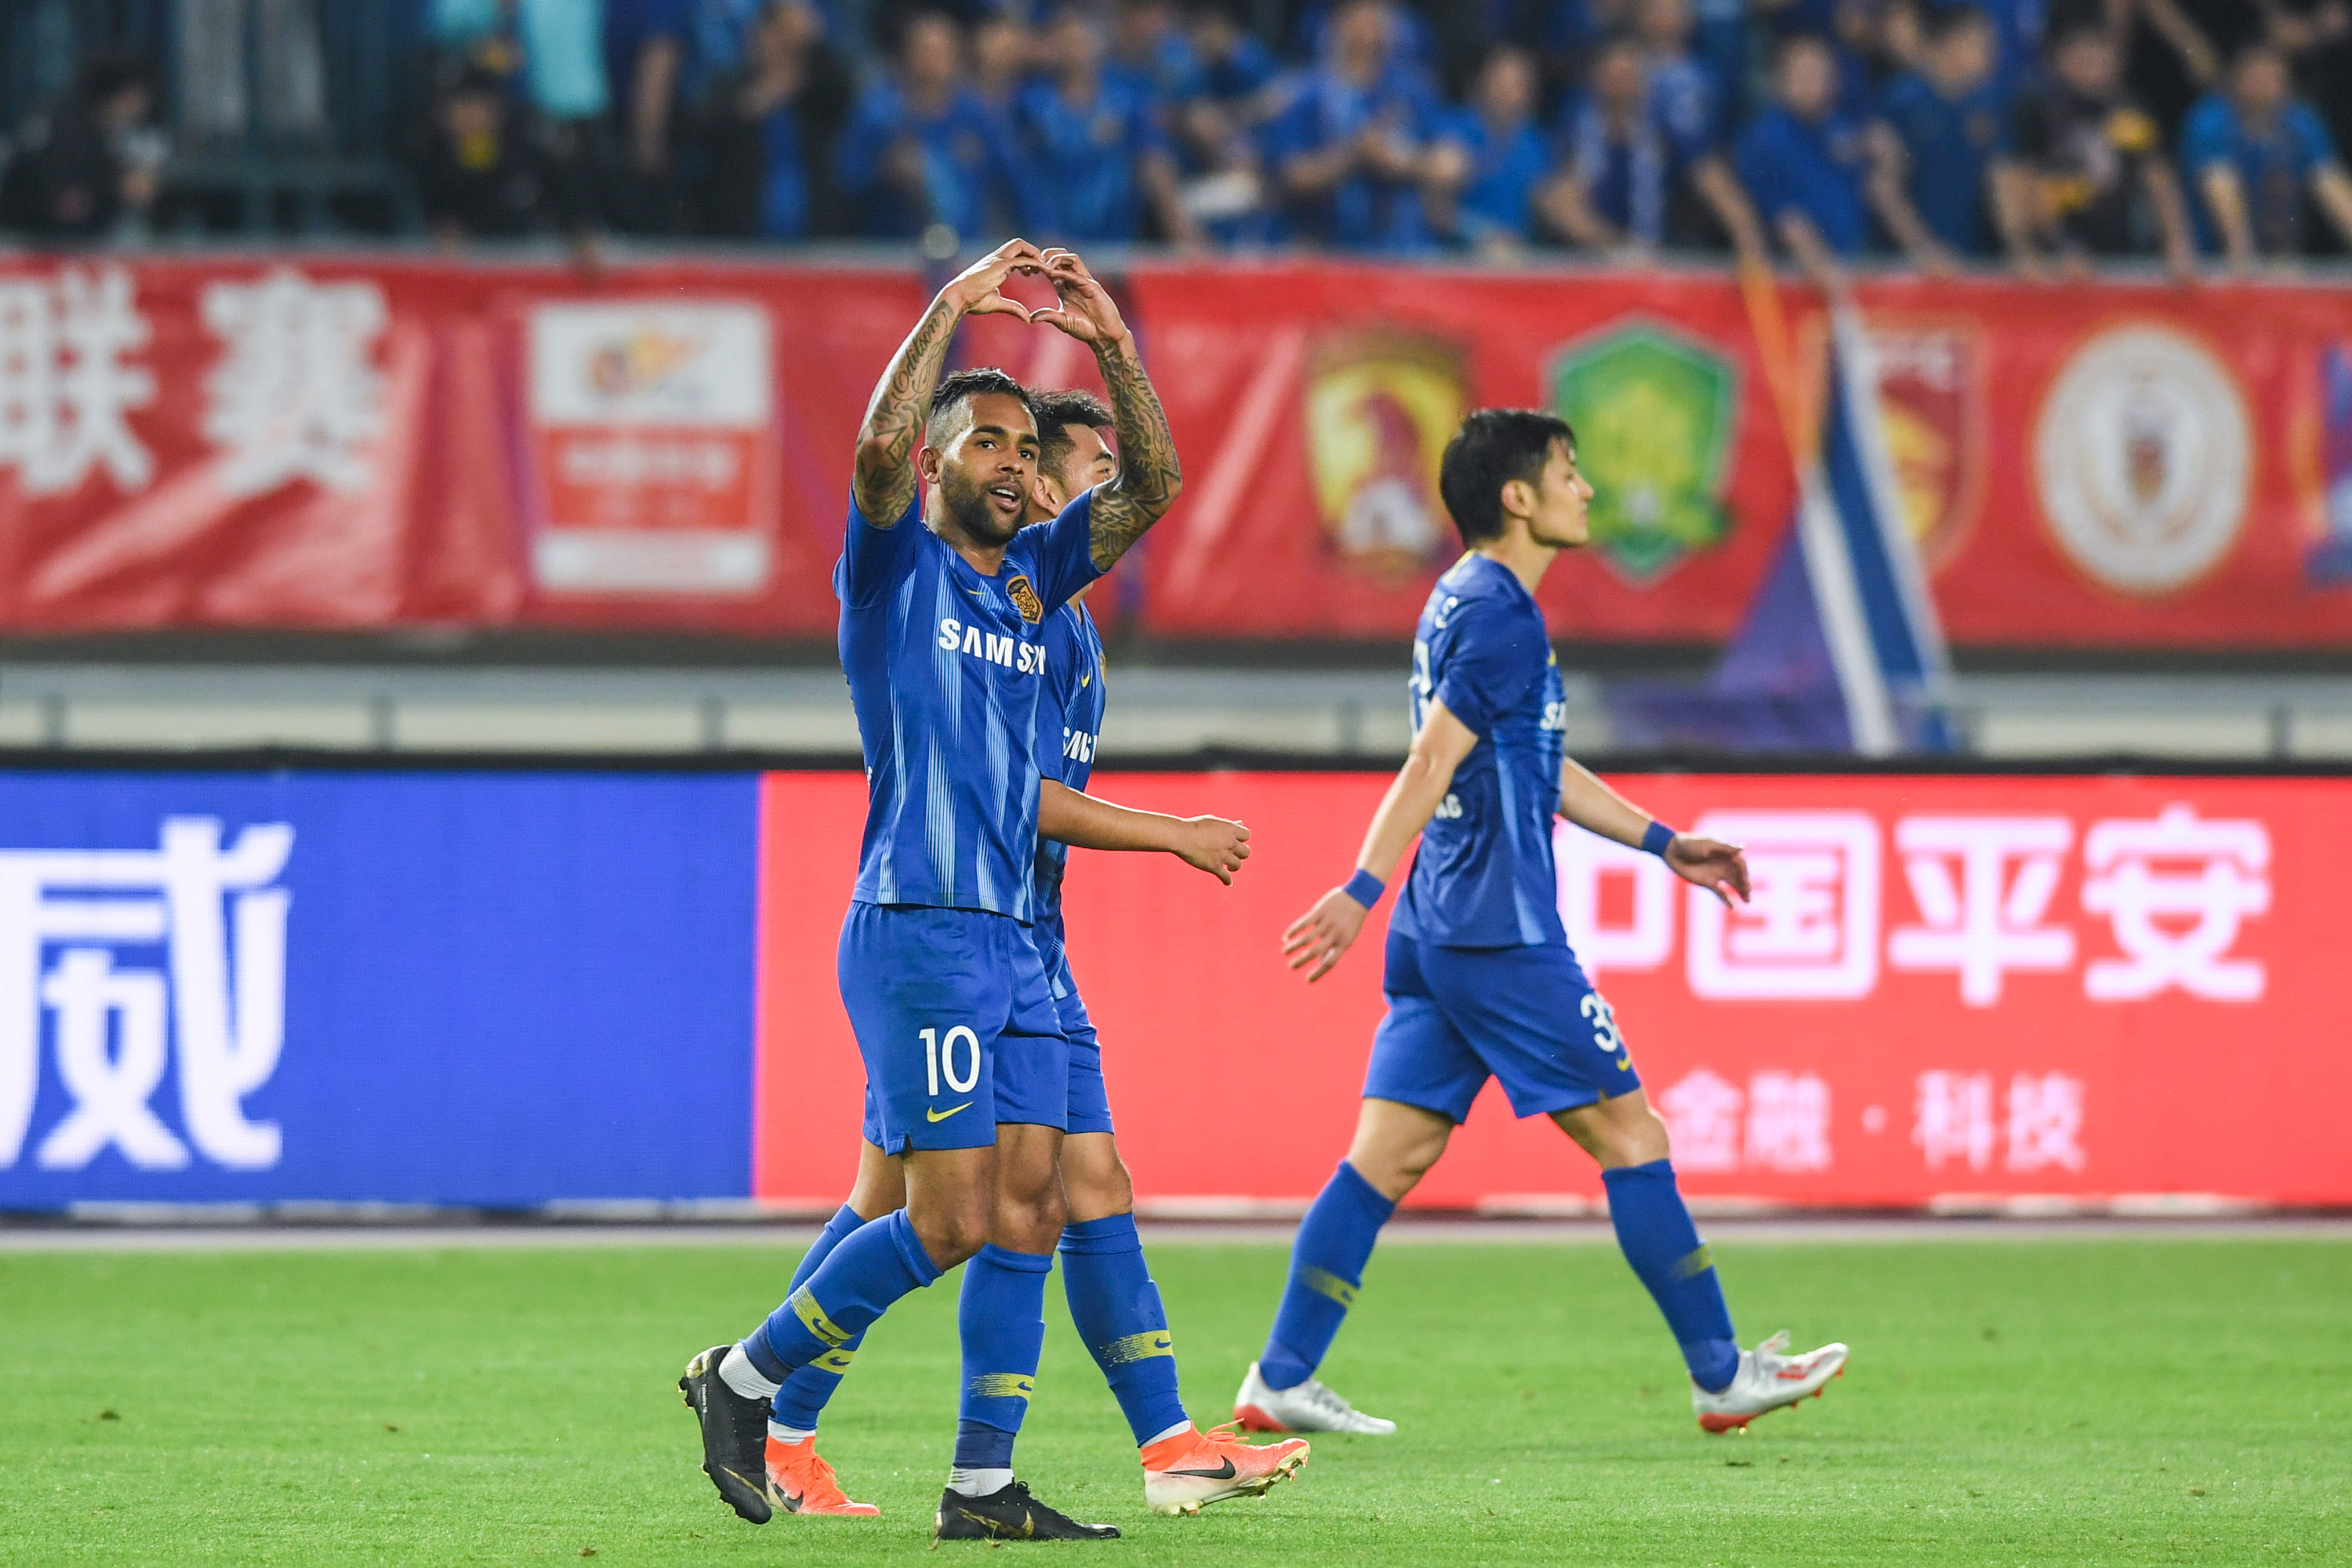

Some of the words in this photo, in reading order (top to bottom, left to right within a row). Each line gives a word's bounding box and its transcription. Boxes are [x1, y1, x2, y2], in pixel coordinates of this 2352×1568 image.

[0, 814, 296, 1170] 威
[1580, 993, 1618, 1053] 3
[918, 1025, 981, 1096] 10
